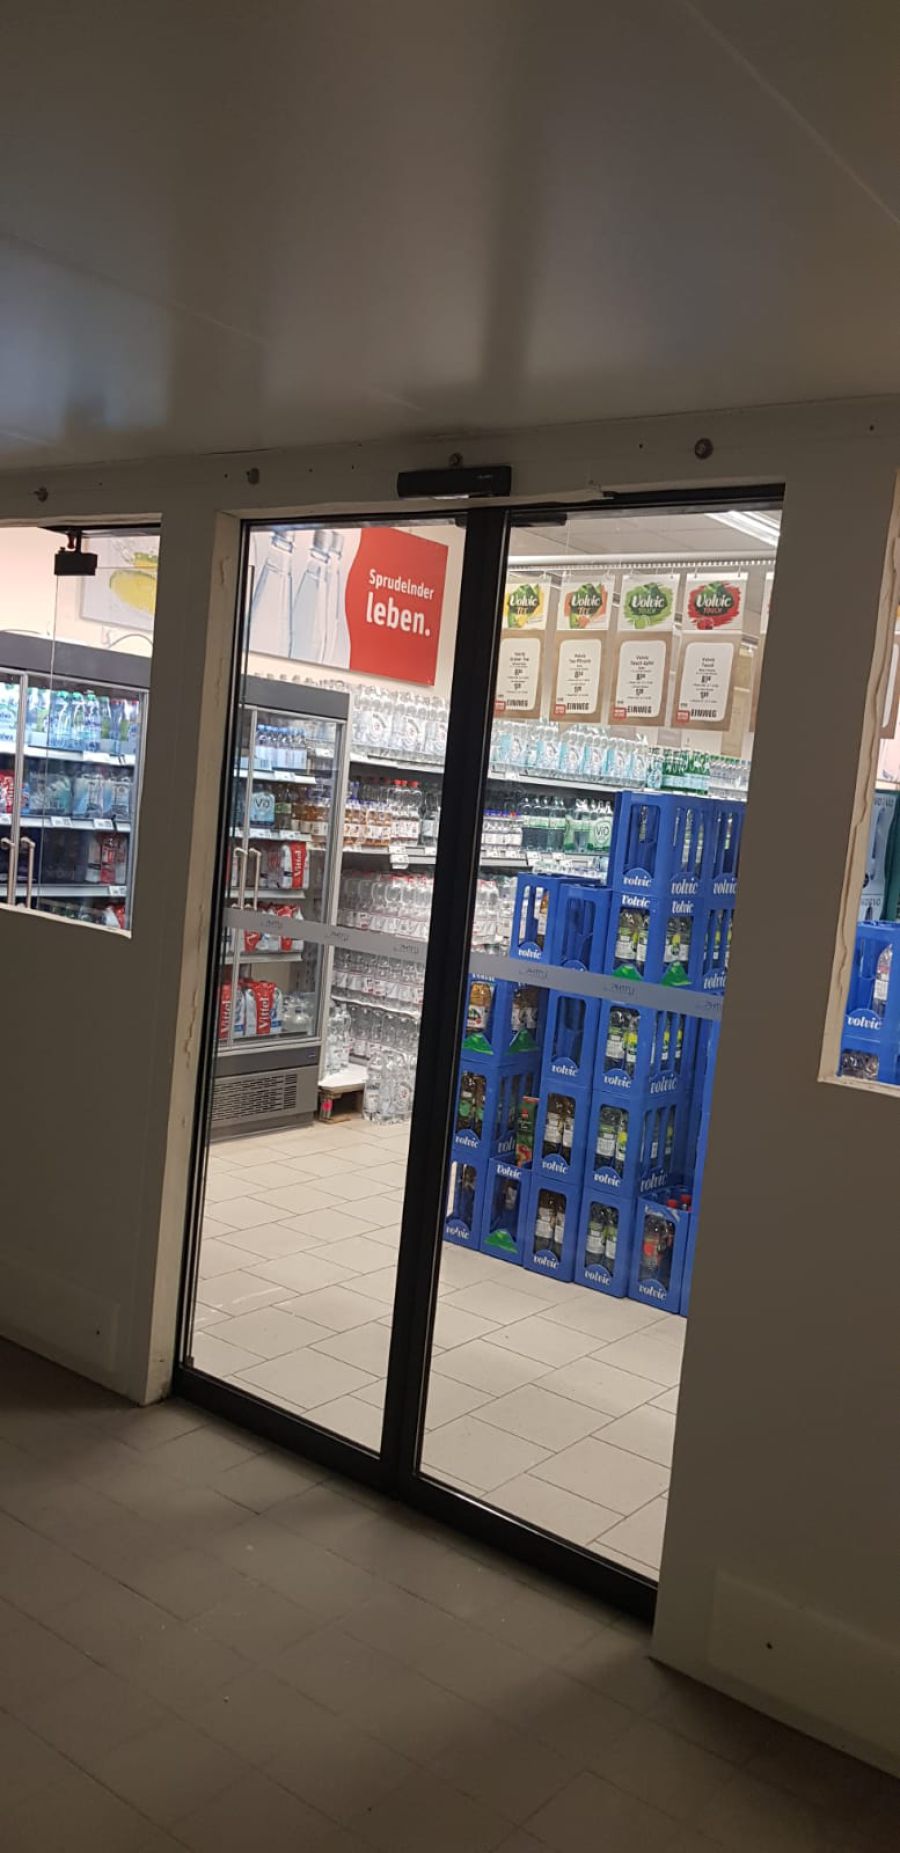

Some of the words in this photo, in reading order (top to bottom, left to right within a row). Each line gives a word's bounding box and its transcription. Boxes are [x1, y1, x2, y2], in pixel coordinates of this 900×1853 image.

[369, 568, 435, 600] Sprudelnder
[571, 594, 600, 607] Volvic
[632, 594, 665, 608] Volvic
[696, 593, 731, 608] Volvic
[366, 592, 431, 637] leben.
[627, 705, 652, 714] EINWEG
[690, 708, 717, 718] EINWEG
[258, 997, 270, 1029] Vittel
